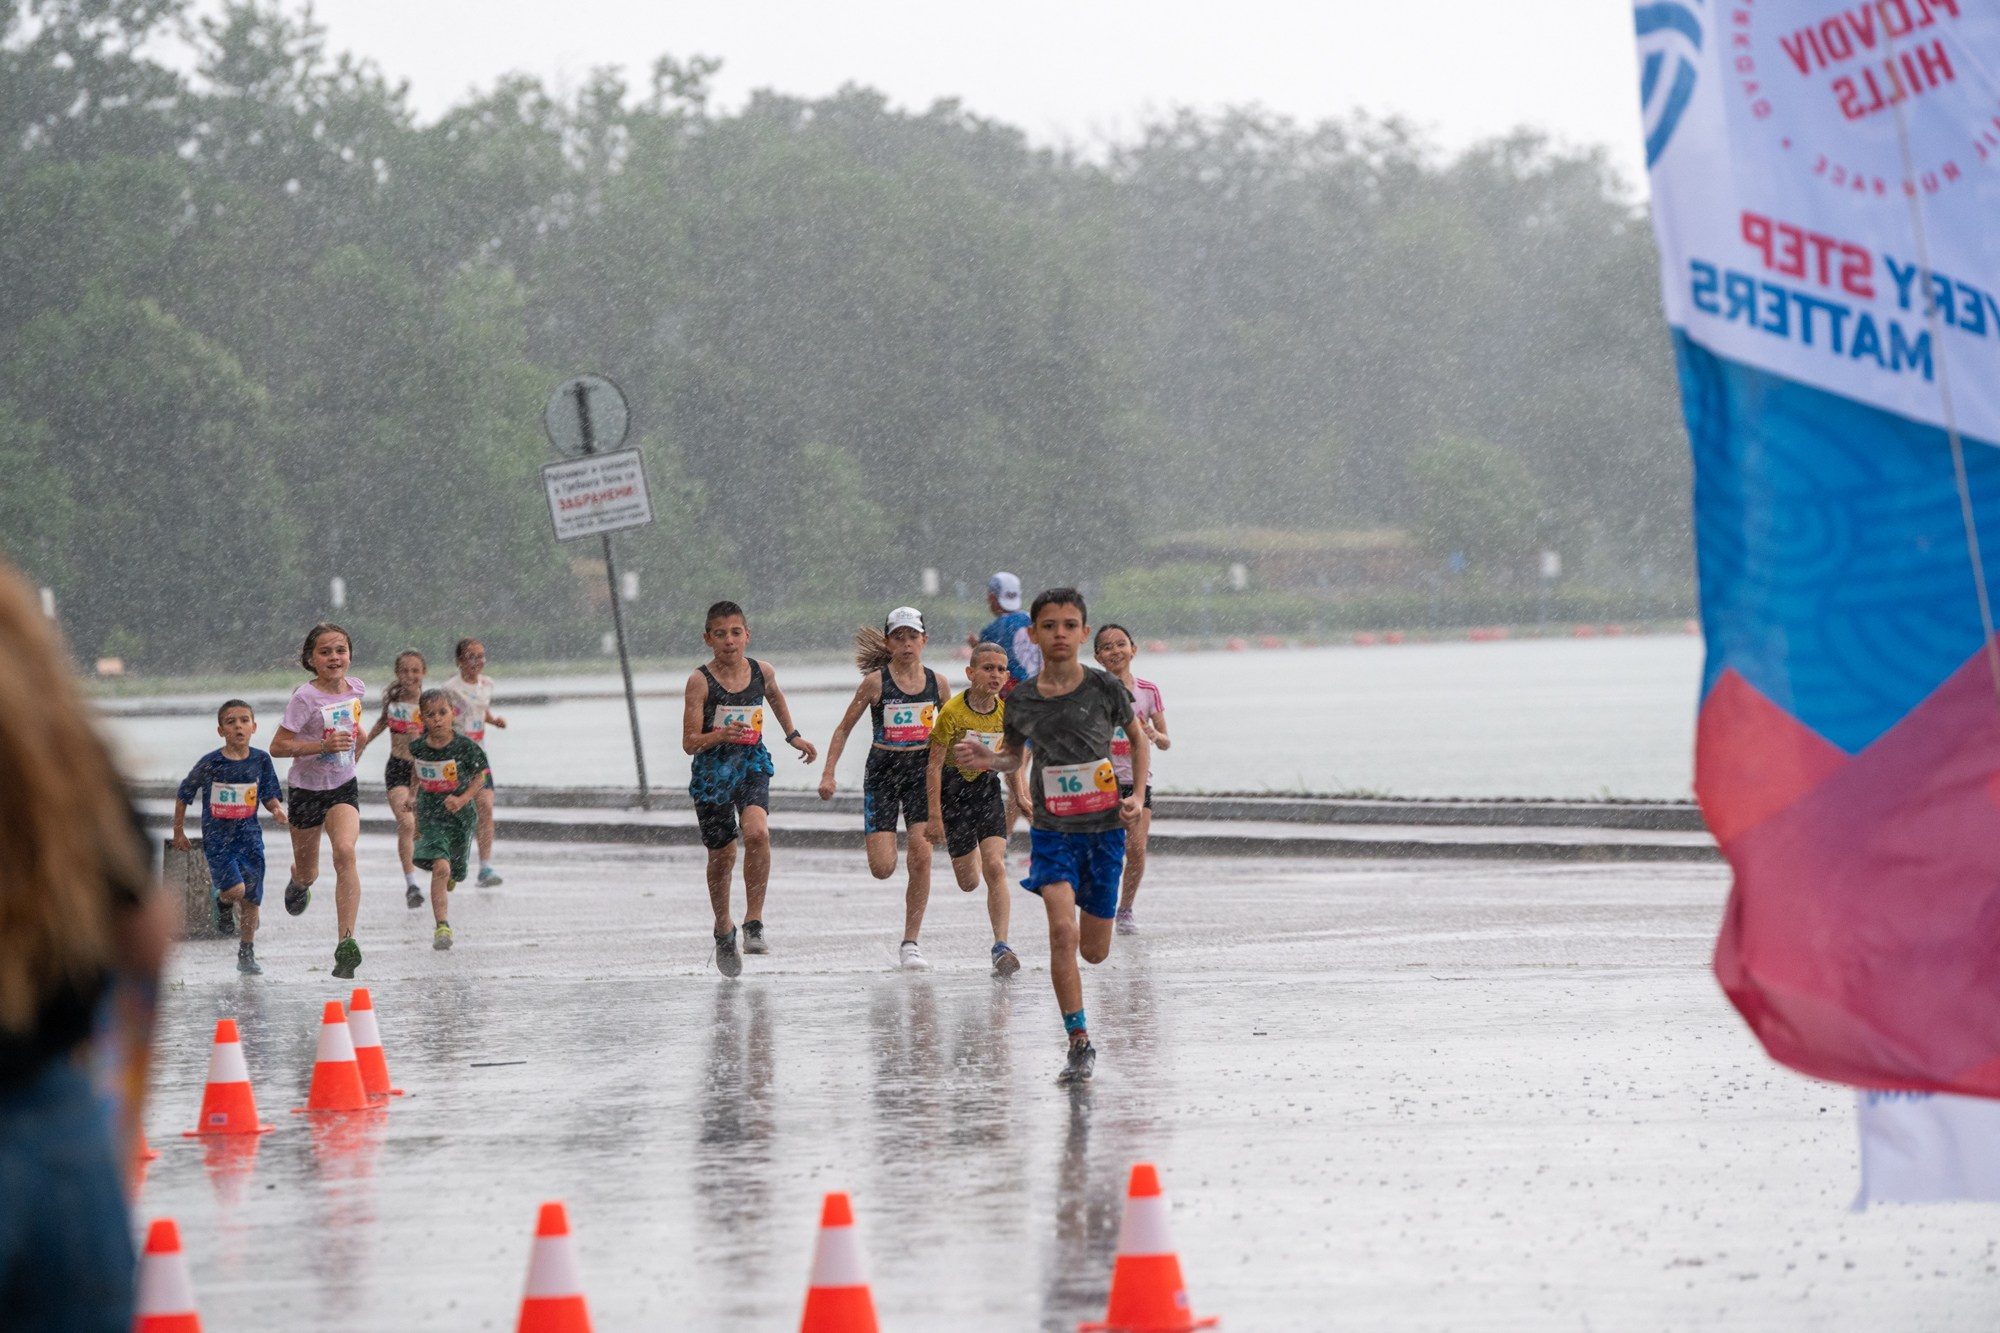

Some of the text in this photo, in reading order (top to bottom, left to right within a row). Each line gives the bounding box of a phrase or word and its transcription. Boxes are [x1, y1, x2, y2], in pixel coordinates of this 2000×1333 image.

[893, 711, 912, 725] 62
[1058, 776, 1083, 792] 16
[220, 790, 236, 803] 81
